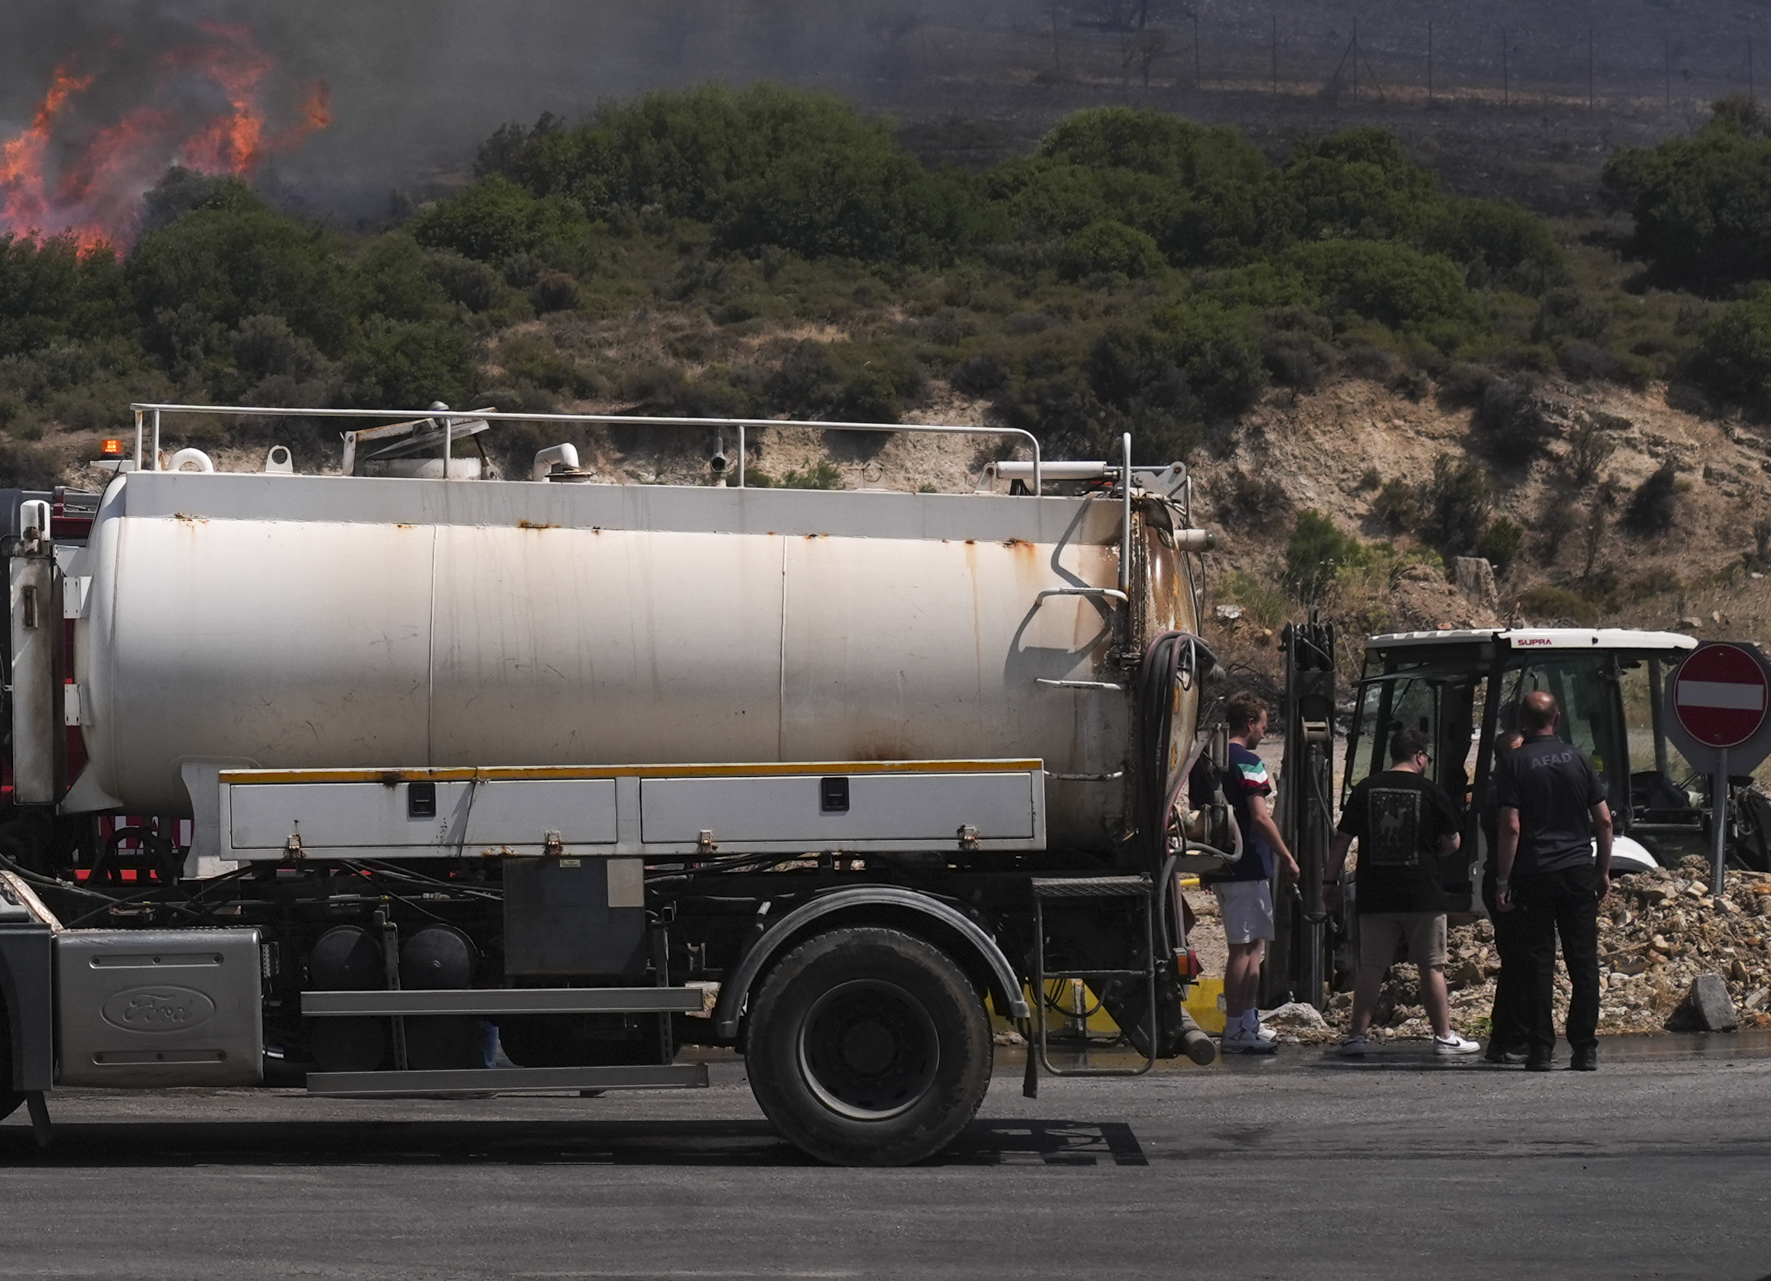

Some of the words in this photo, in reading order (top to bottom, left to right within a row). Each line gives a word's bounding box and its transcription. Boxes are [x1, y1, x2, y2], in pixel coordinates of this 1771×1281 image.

[1517, 638, 1552, 646] SUPRA
[1531, 752, 1572, 769] AFAD
[122, 994, 194, 1023] Ford
